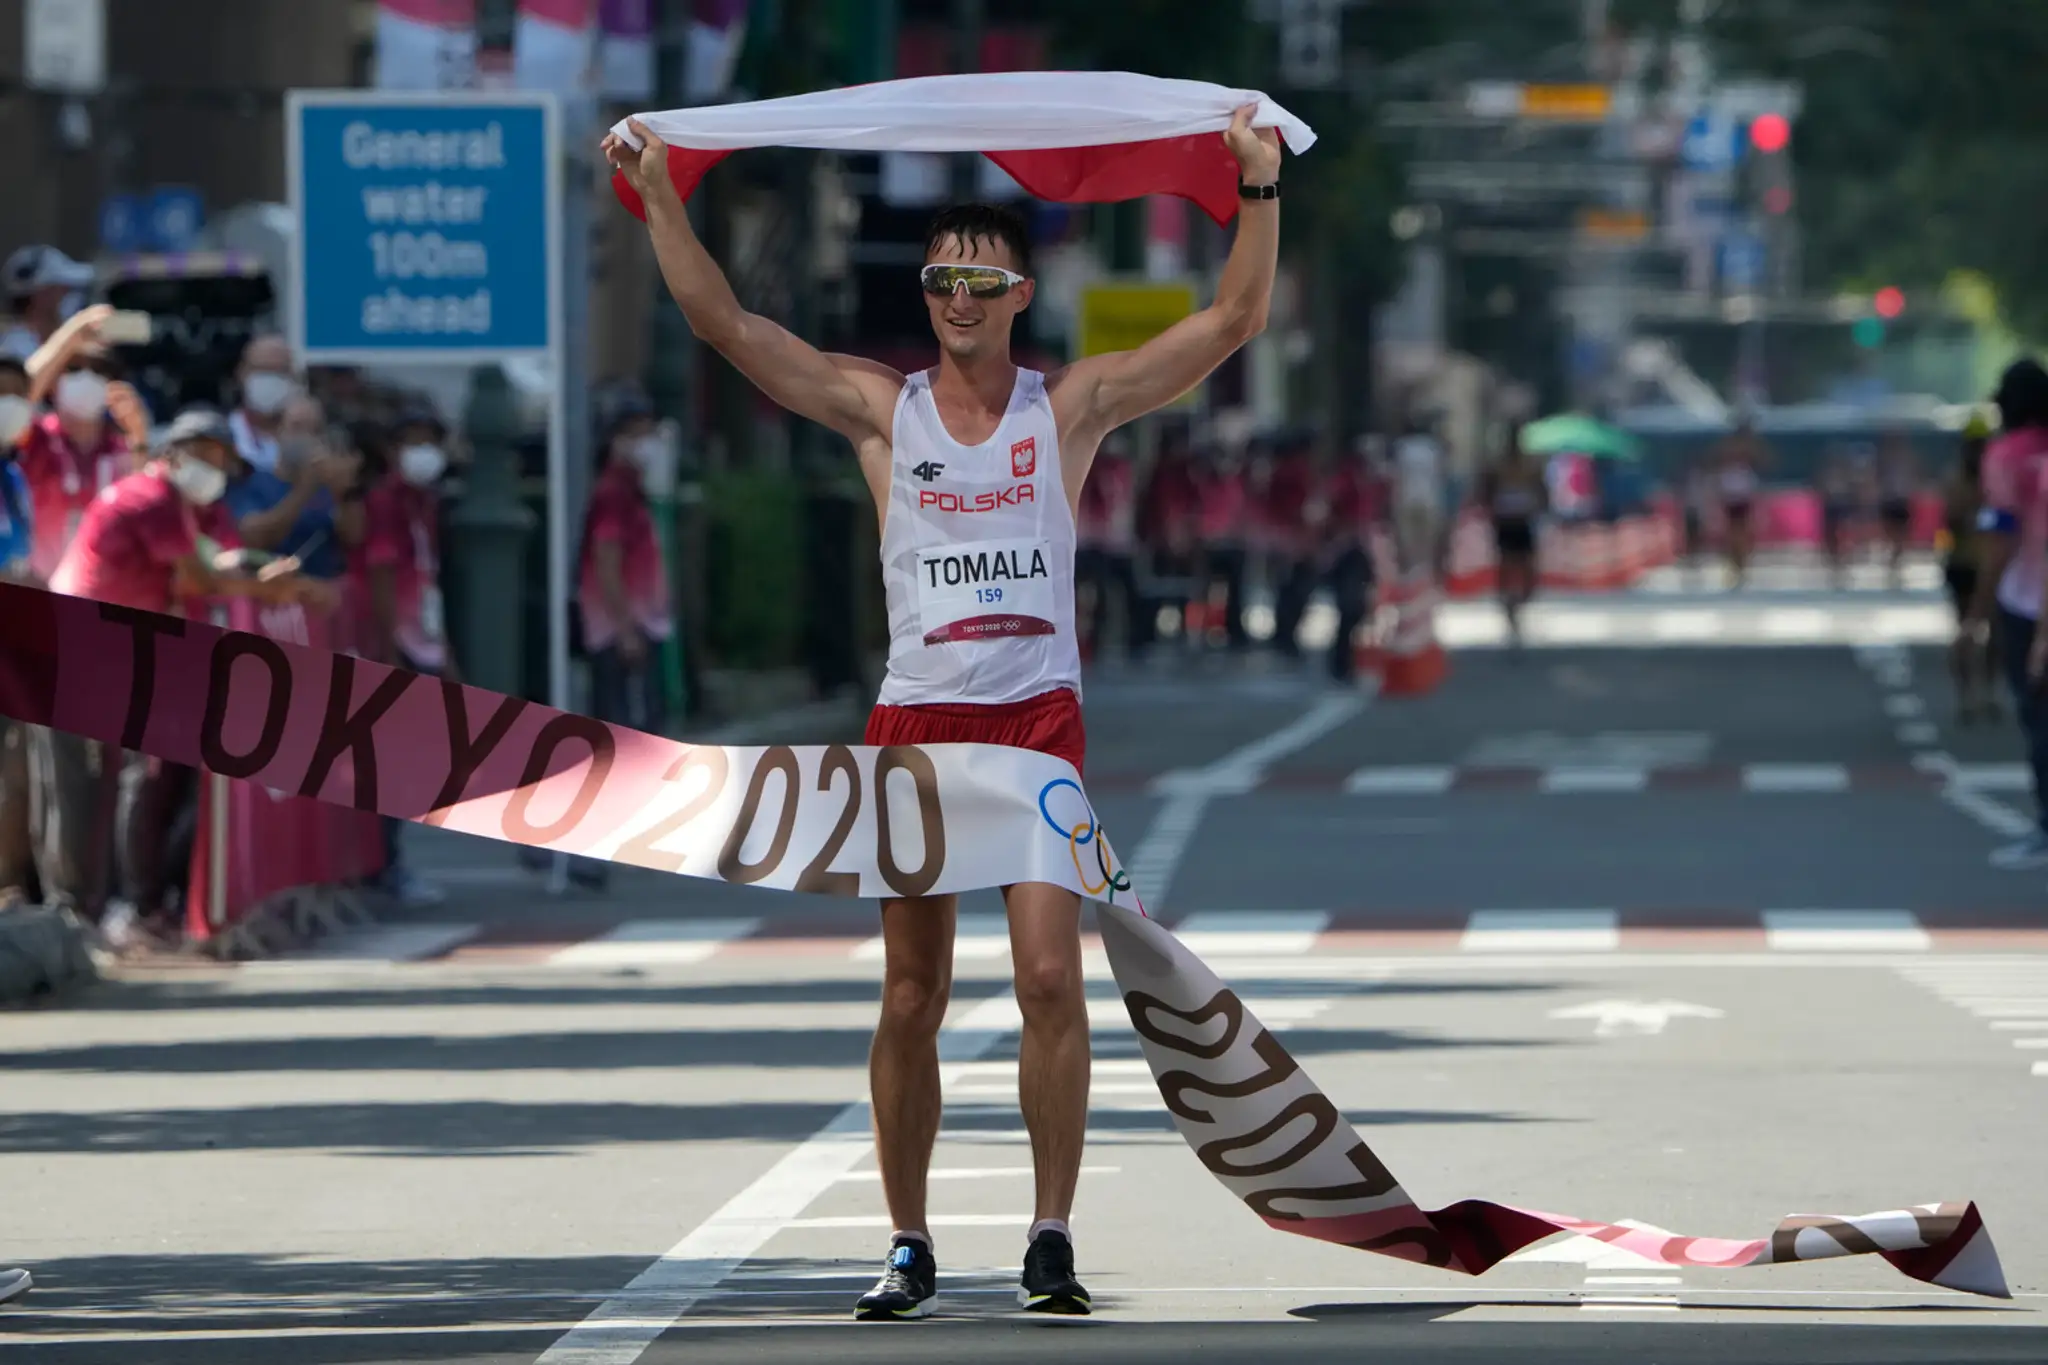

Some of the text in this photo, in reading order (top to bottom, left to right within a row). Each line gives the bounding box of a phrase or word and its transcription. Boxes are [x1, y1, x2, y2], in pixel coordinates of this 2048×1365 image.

[342, 119, 505, 169] General
[361, 181, 488, 225] water
[368, 232, 488, 278] 100m
[361, 287, 492, 335] ahead
[912, 461, 945, 482] 4F
[919, 483, 1035, 513] POLSKA
[923, 548, 1048, 588] TOMALA
[975, 588, 1003, 603] 159
[962, 623, 1001, 633] TOKYO 2020
[98, 601, 946, 897] TOKYO 2020
[1123, 988, 1399, 1221] 2020
